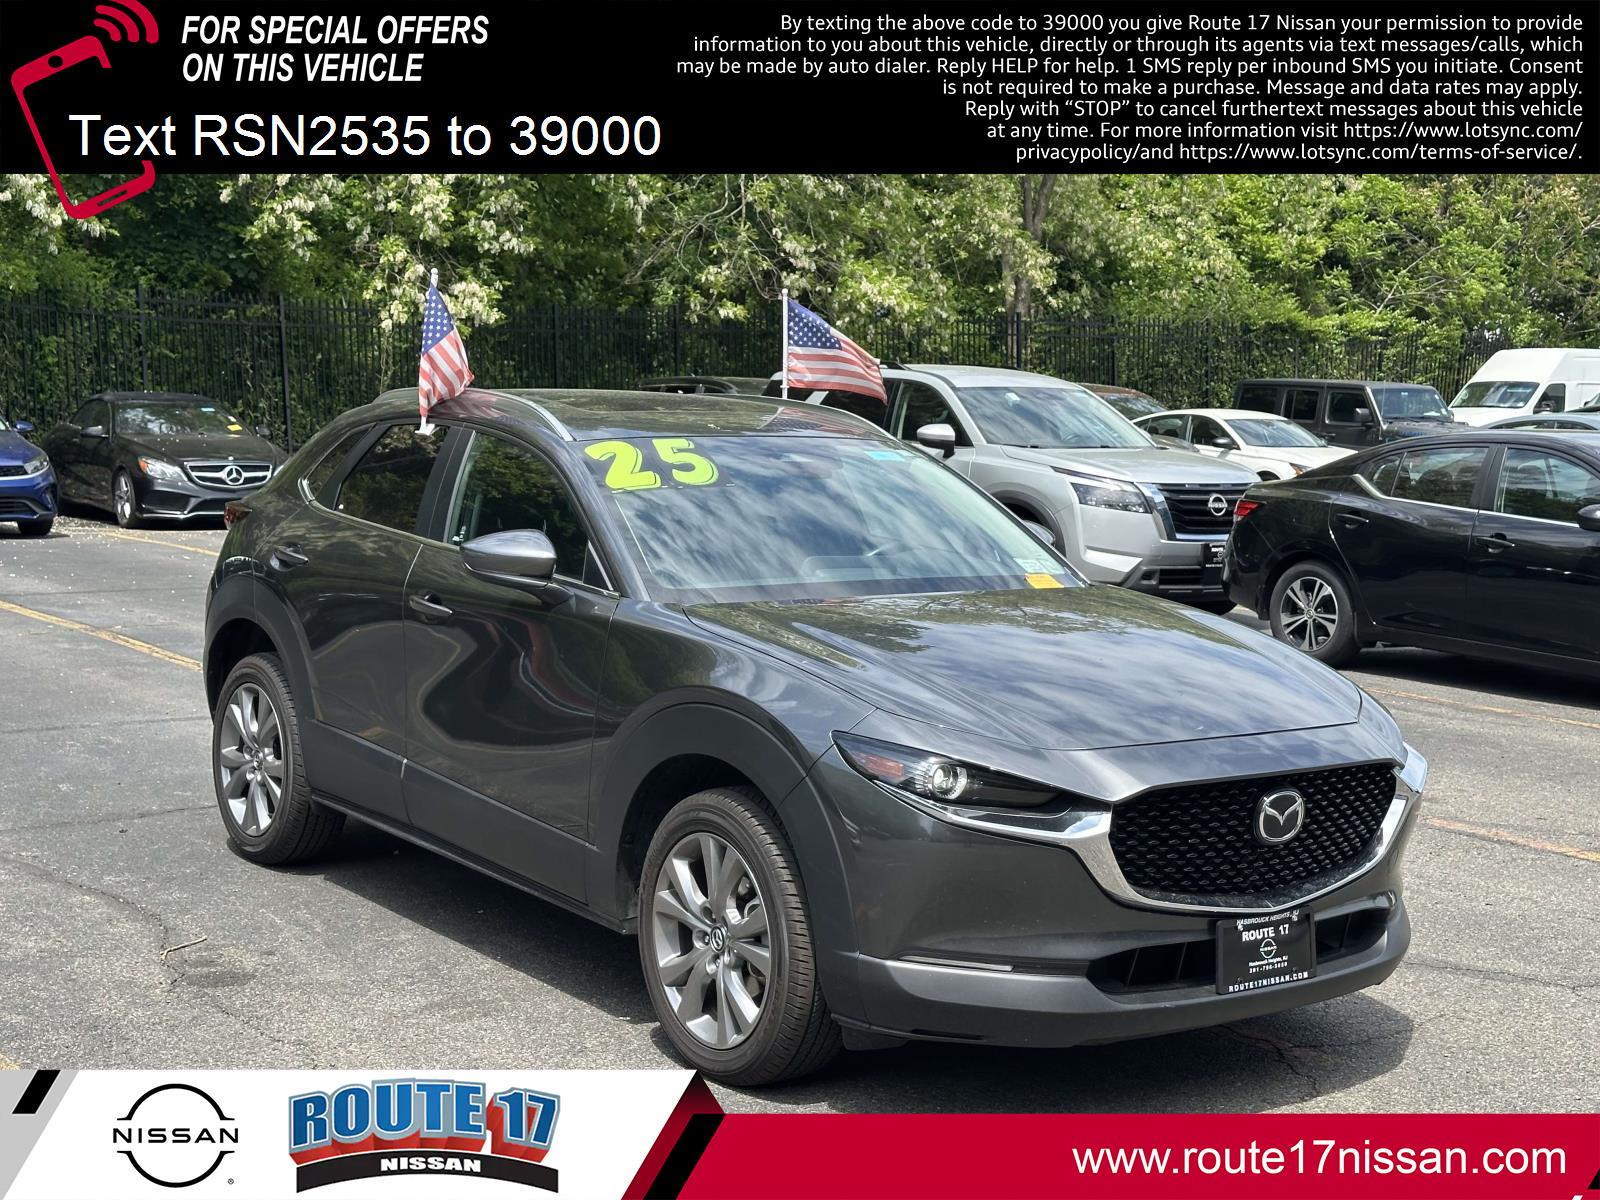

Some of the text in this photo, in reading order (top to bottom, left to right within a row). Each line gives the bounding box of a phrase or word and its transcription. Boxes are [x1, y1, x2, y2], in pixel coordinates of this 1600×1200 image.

[584, 438, 720, 491] 25
[1236, 915, 1269, 926] HASBROUCK
[1241, 923, 1290, 942] ROUTE 17
[1228, 971, 1309, 993] ROUTE17NISSAN.COM
